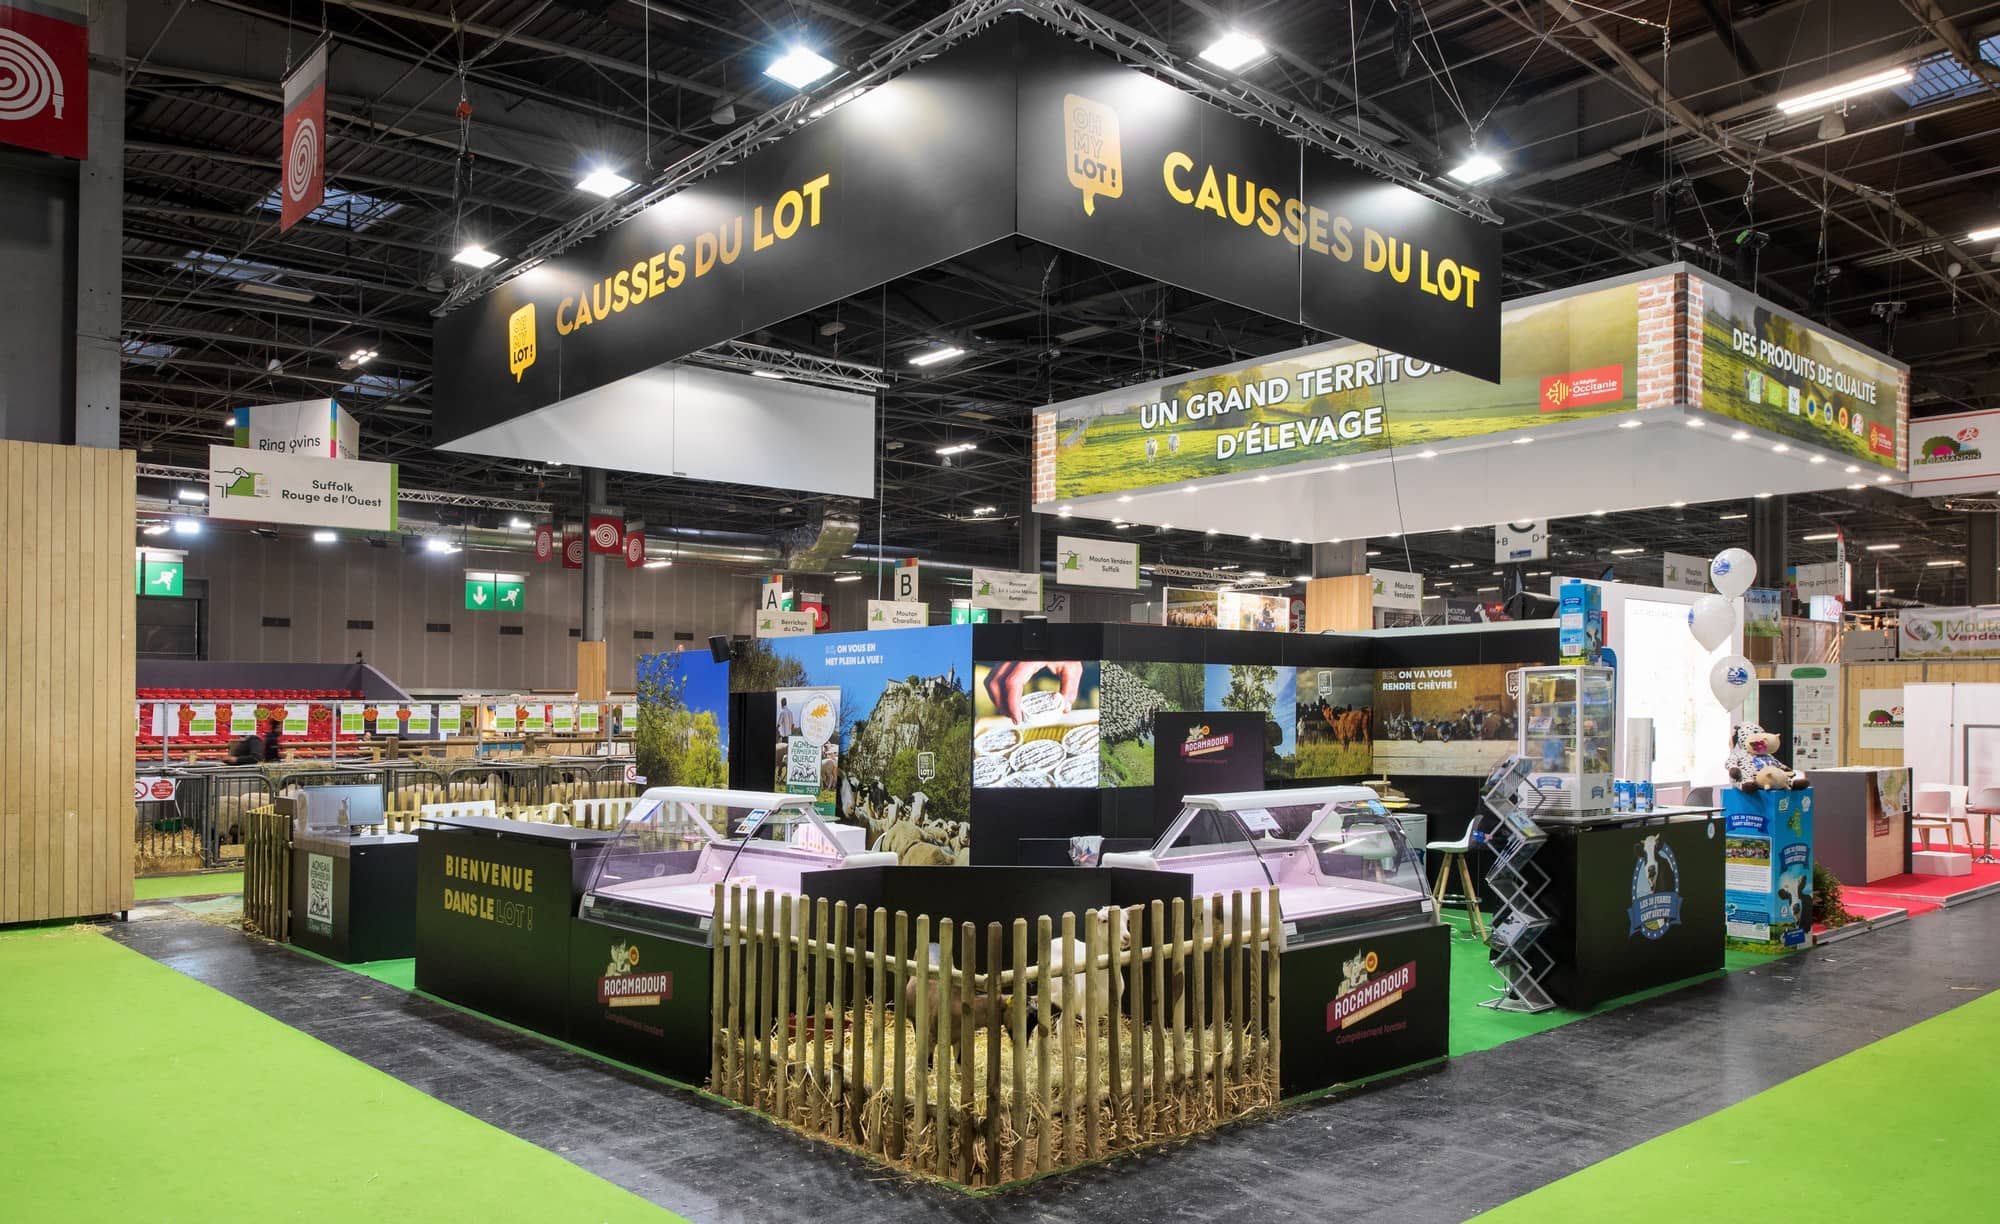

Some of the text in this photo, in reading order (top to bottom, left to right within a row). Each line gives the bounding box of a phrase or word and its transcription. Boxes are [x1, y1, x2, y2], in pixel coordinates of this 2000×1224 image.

[1072, 106, 1102, 136] OH
[1073, 129, 1105, 157] MY
[1162, 151, 1480, 309] CAUSSES DU LOT
[555, 173, 830, 336] CAUSSES DU LOT
[1733, 327, 1876, 405] DES PRODUITS DE QUALITÉ
[1140, 353, 1448, 429] UN GRAND TERRITO
[1573, 380, 1617, 394] Occitanie
[259, 439, 286, 453] Ring
[289, 435, 321, 450] ovins
[1216, 407, 1383, 460] D'ÉLEVAGE
[312, 479, 353, 492] Suffolk
[281, 489, 382, 507] Rouge de l'Ouest
[1089, 555, 1110, 563] Mouton
[901, 574, 912, 596] B
[766, 589, 778, 610] A
[1947, 632, 2000, 641] Vendé
[1399, 670, 1412, 678] ON
[1413, 670, 1426, 678] VA
[1427, 669, 1453, 678] VOUS
[1382, 682, 1416, 690] RENDRE
[1417, 680, 1453, 690] CHÈVRE
[1184, 735, 1229, 752] ROCAMADOUR
[445, 854, 533, 893] BIENVENUE
[444, 888, 478, 917] DANS
[479, 896, 495, 920] LE
[495, 899, 525, 929] LOT
[604, 975, 667, 996] ROCAMADOUR
[1334, 967, 1409, 1020] ROCAMADOUR
